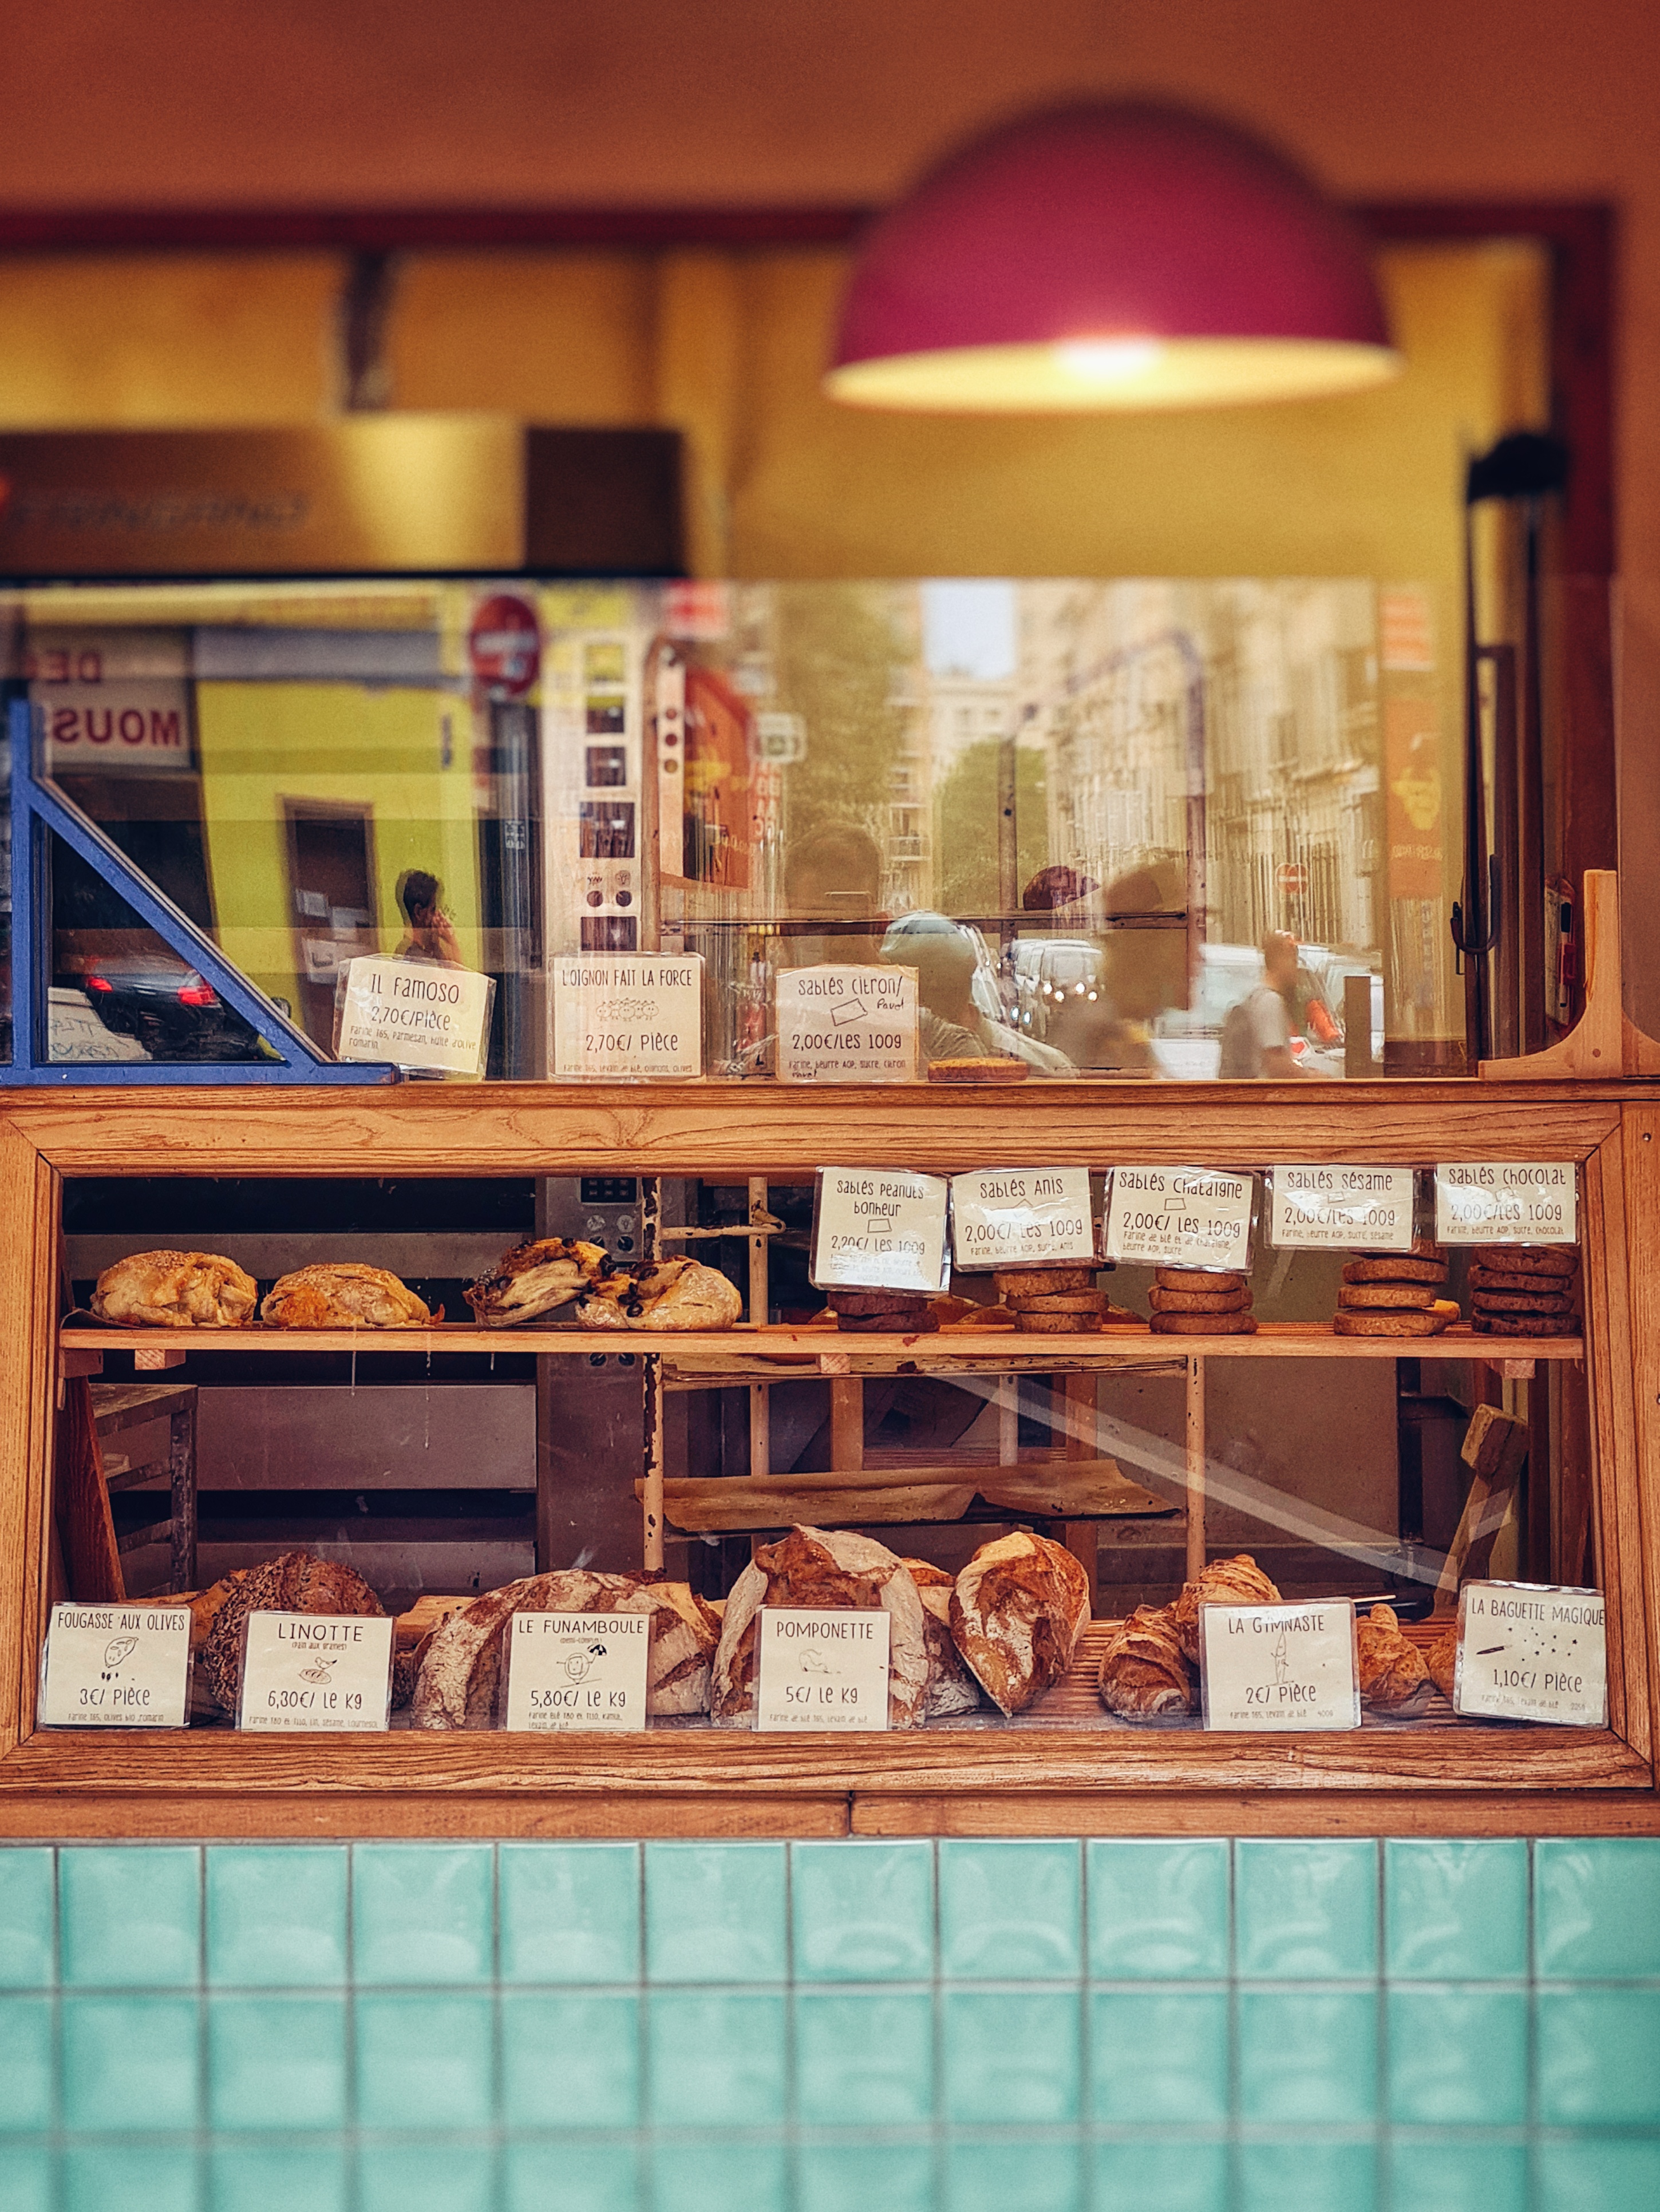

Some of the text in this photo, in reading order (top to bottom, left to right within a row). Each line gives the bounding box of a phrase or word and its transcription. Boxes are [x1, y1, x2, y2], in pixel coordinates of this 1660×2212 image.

[371, 974, 382, 994] IL
[614, 970, 636, 986] FAIT
[642, 970, 654, 986] LA
[660, 970, 692, 986] FORCE
[586, 1035, 632, 1053] 2,70€/
[869, 1034, 902, 1049] 100g
[1034, 1177, 1063, 1196] Anis
[854, 1201, 901, 1217] bonheur
[1529, 1204, 1562, 1221] 100g
[1050, 1219, 1083, 1237] 100g
[1123, 1212, 1170, 1231] 2,00€/
[1208, 1220, 1240, 1238] 100g
[1472, 1598, 1604, 1626] LA BAGUETTE MAGIQUE
[58, 1612, 184, 1631] FOUGASSE AUX OLIVES
[519, 1620, 645, 1633] LE FUNAMBOULE
[777, 1621, 874, 1639] POMPONETTE
[1229, 1618, 1244, 1634] LA
[278, 1623, 363, 1641] LINOTTE
[1493, 1669, 1536, 1688] 1,10€/
[268, 1691, 315, 1709] 6,30€/
[531, 1691, 578, 1708] 5,80€/
[786, 1687, 811, 1703] 5€/
[1246, 1687, 1270, 1703] 2€/
